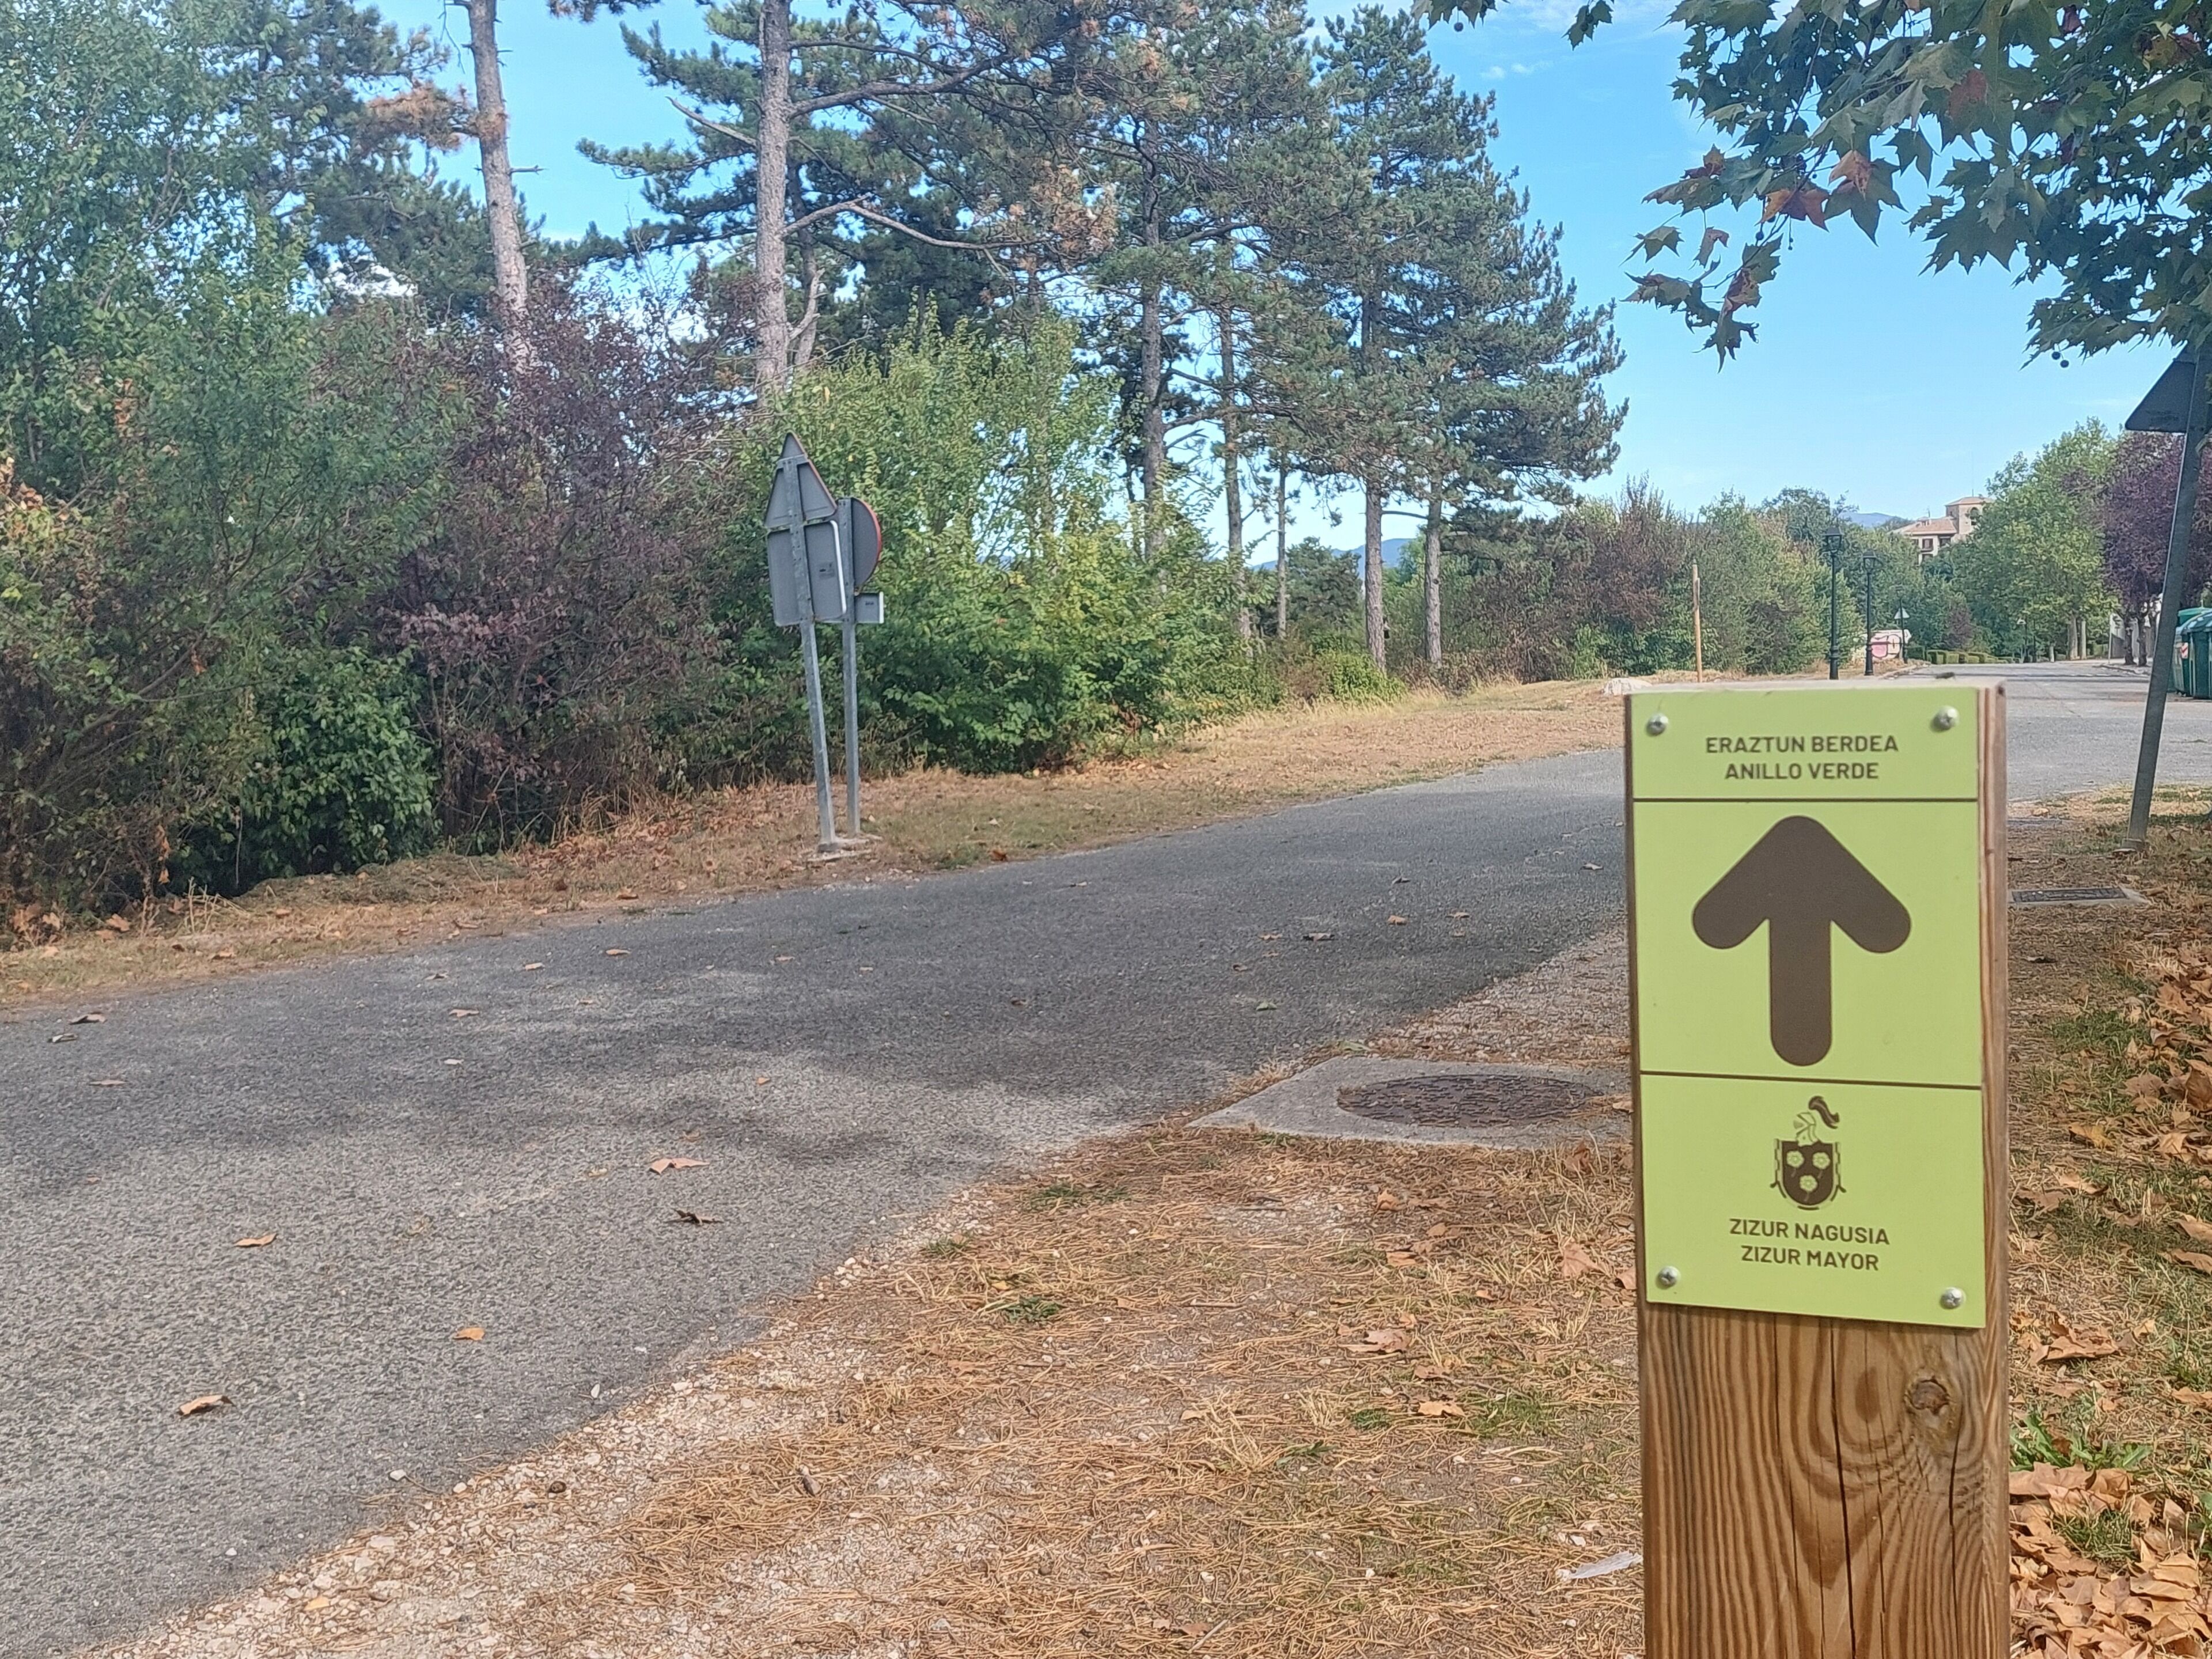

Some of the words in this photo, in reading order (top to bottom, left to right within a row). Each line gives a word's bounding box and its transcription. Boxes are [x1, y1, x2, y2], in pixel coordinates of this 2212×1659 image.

[1706, 736, 1805, 753] ERAZTUN
[1812, 735, 1899, 753] BERDEA
[1725, 763, 1802, 780] ANILLO
[1808, 762, 1878, 779] VERDE
[1729, 1218, 1789, 1238] ZIZUR
[1795, 1222, 1890, 1245] NAGUSIA
[1741, 1245, 1801, 1266] ZIZUR
[1806, 1250, 1878, 1271] MAYOR
